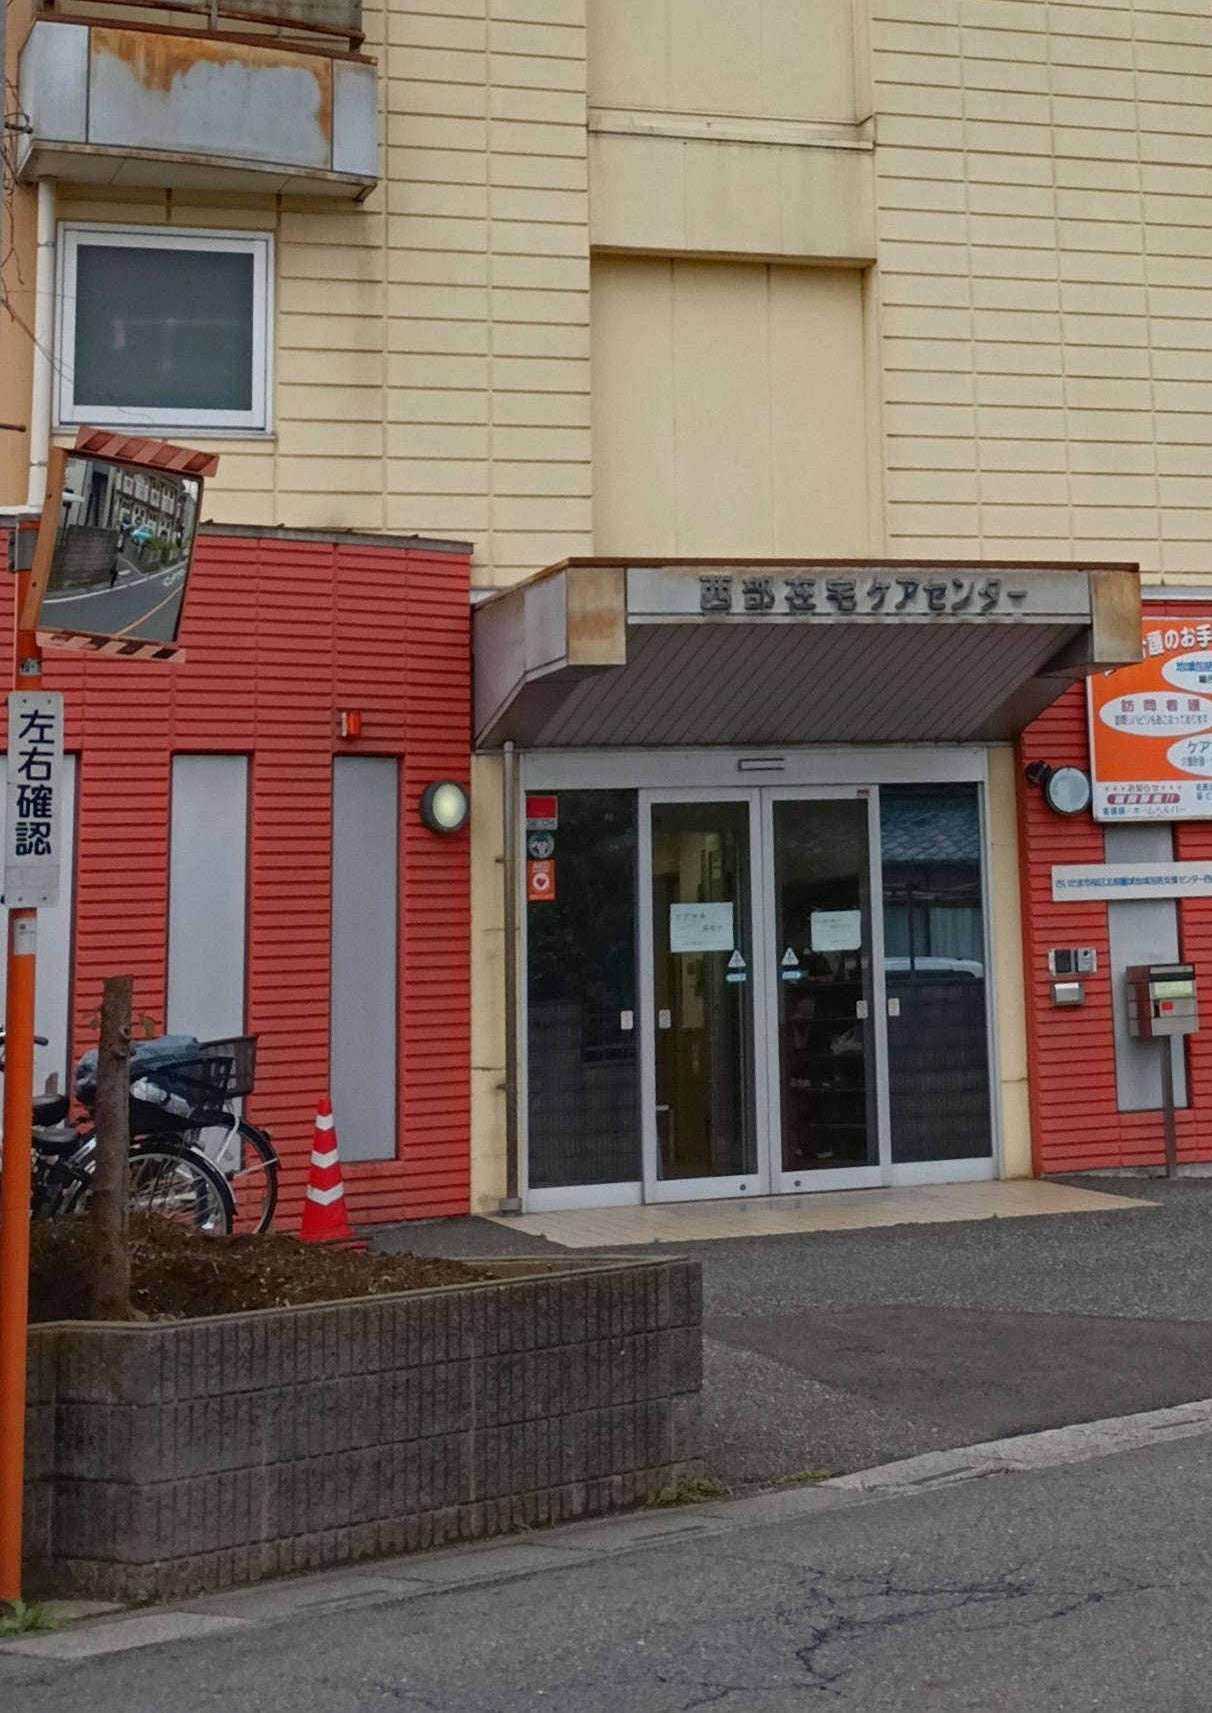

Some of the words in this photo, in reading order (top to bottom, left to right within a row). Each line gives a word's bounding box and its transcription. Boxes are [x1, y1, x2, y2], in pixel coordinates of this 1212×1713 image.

[699, 574, 1027, 612] 西部在宅ケアセンター
[1121, 699, 1200, 712] 訪問看護
[15, 710, 56, 857] 左右確認
